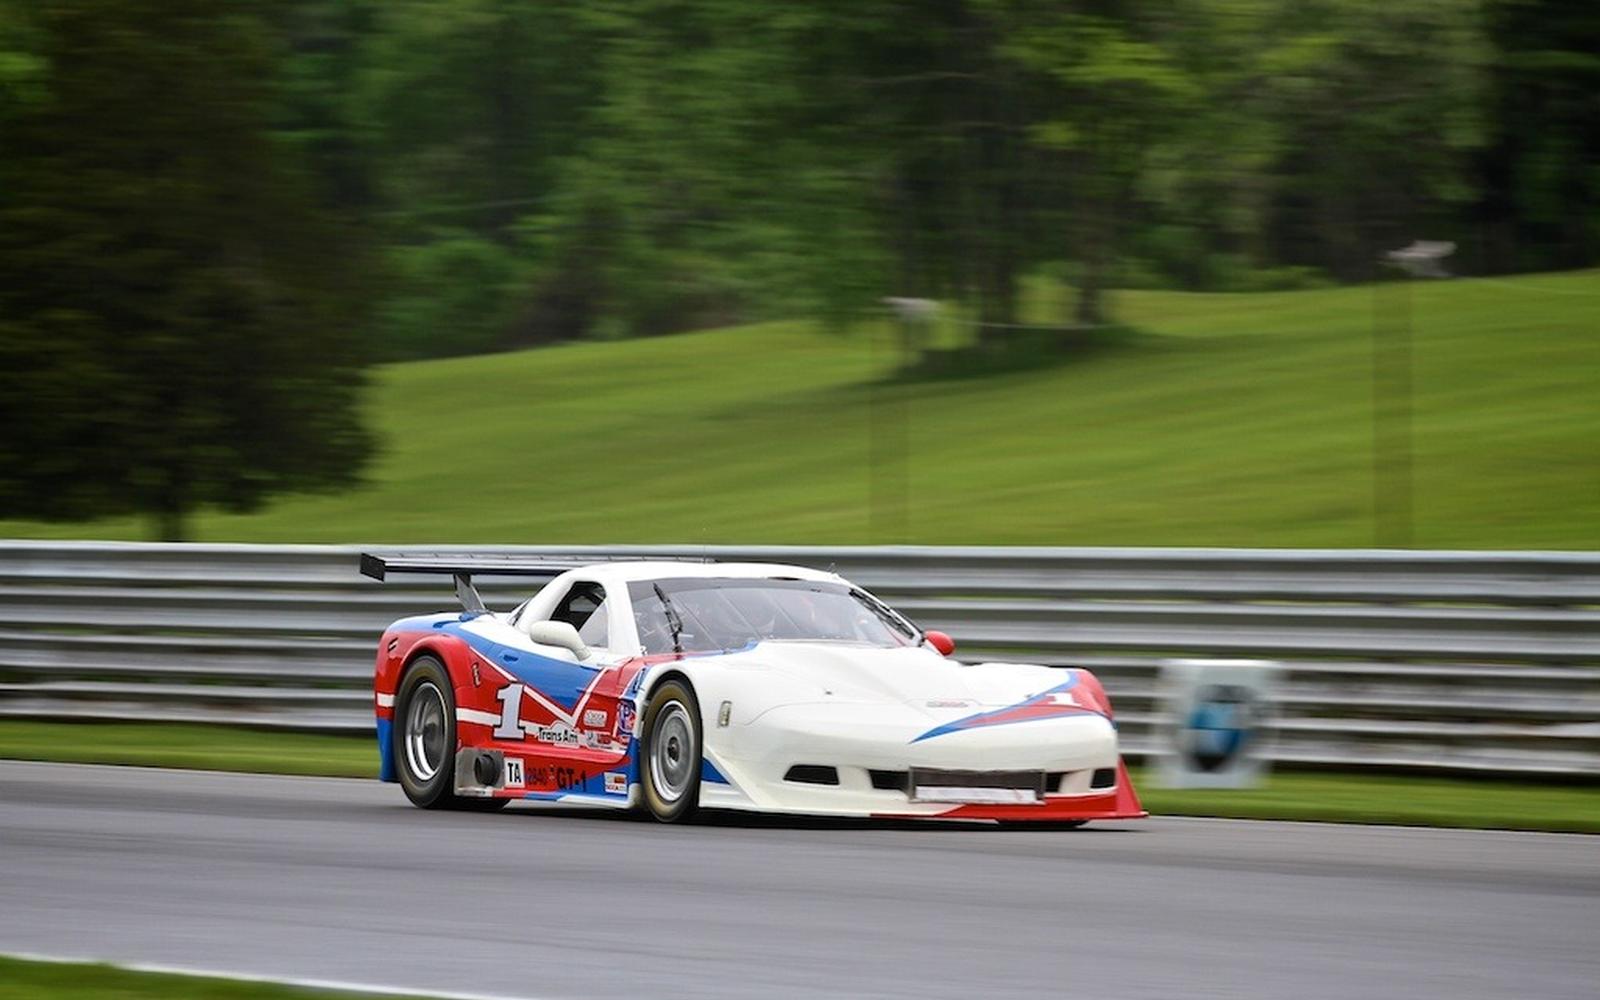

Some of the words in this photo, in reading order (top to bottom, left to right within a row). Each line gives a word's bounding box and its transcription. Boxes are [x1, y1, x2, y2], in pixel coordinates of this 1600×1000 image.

[493, 683, 525, 739] 1
[507, 763, 521, 783] TA
[557, 767, 586, 791] GT-1
